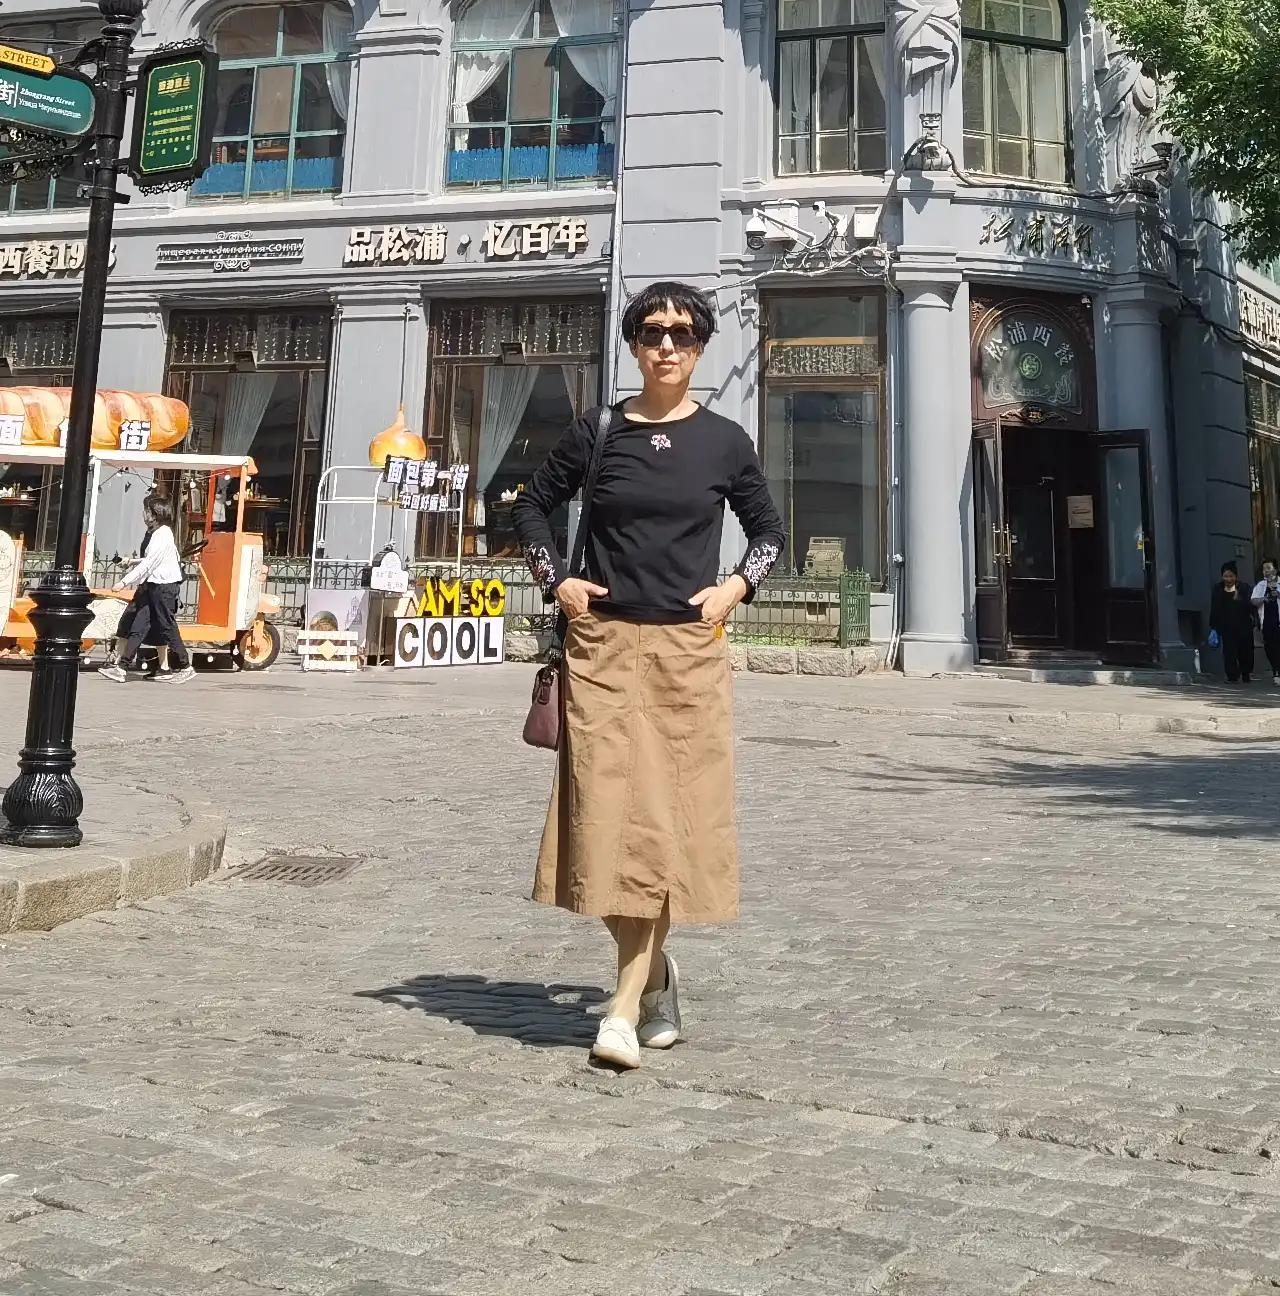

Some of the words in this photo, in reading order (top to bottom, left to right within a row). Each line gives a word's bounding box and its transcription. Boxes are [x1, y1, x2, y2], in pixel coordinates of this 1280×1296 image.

[54, 95, 76, 106] Street
[470, 578, 506, 616] SO
[397, 621, 498, 663] COOL
